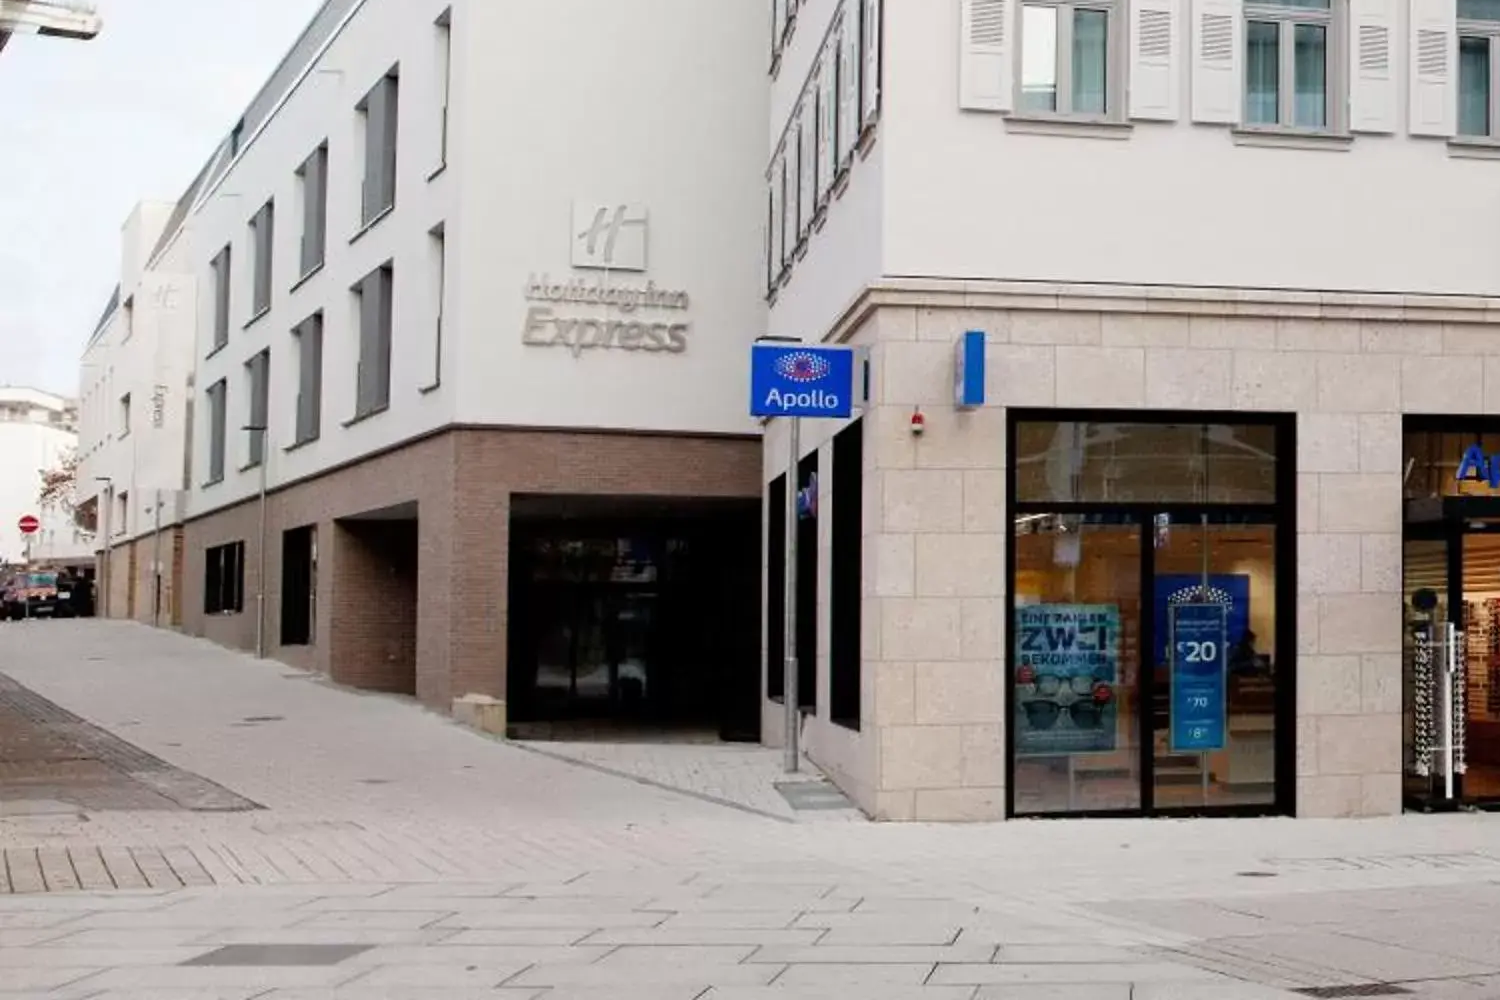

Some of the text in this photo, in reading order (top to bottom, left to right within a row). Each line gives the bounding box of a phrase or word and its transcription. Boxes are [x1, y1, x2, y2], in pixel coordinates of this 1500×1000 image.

[522, 306, 690, 360] Express
[765, 388, 839, 410] Apollo
[1021, 626, 1106, 651] ZWEI
